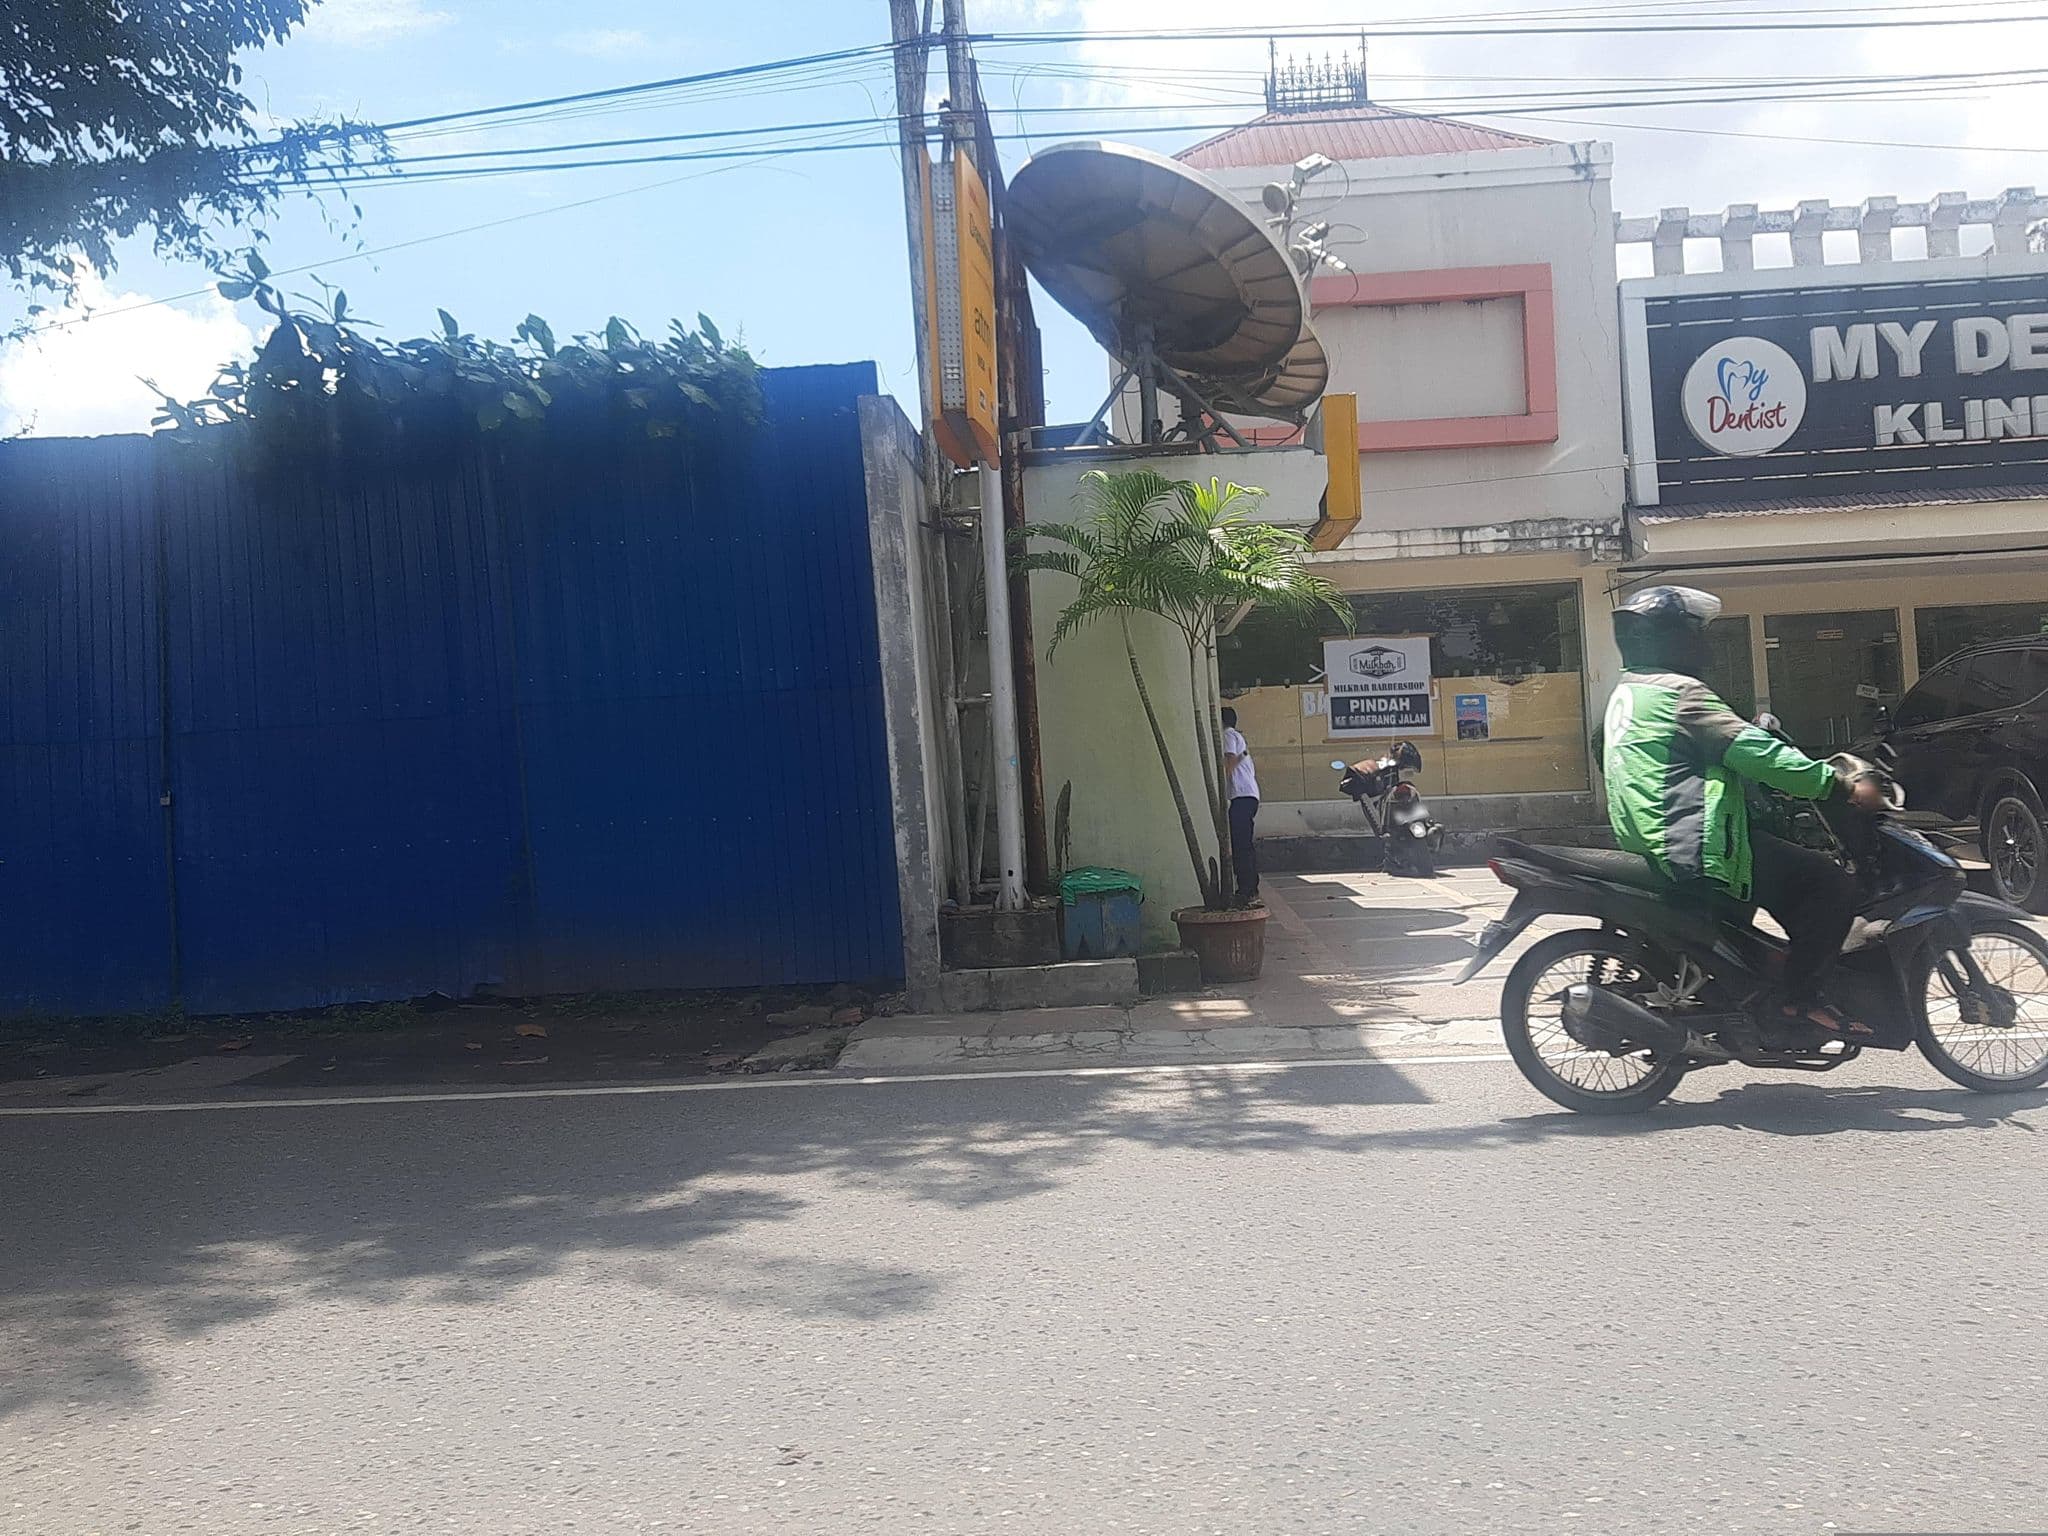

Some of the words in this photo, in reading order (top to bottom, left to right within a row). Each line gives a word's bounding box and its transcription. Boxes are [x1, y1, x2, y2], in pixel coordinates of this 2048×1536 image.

[1809, 319, 1938, 382] MY
[1952, 312, 2048, 373] DE
[1717, 357, 1769, 405] My
[1707, 396, 1787, 433] Dentist
[1359, 655, 1397, 670] Milkbar
[1333, 683, 1370, 693] MILKBAR
[1371, 681, 1425, 692] BARBERSHOP
[1349, 697, 1410, 713] PINDAH
[1398, 712, 1427, 724] JALAN
